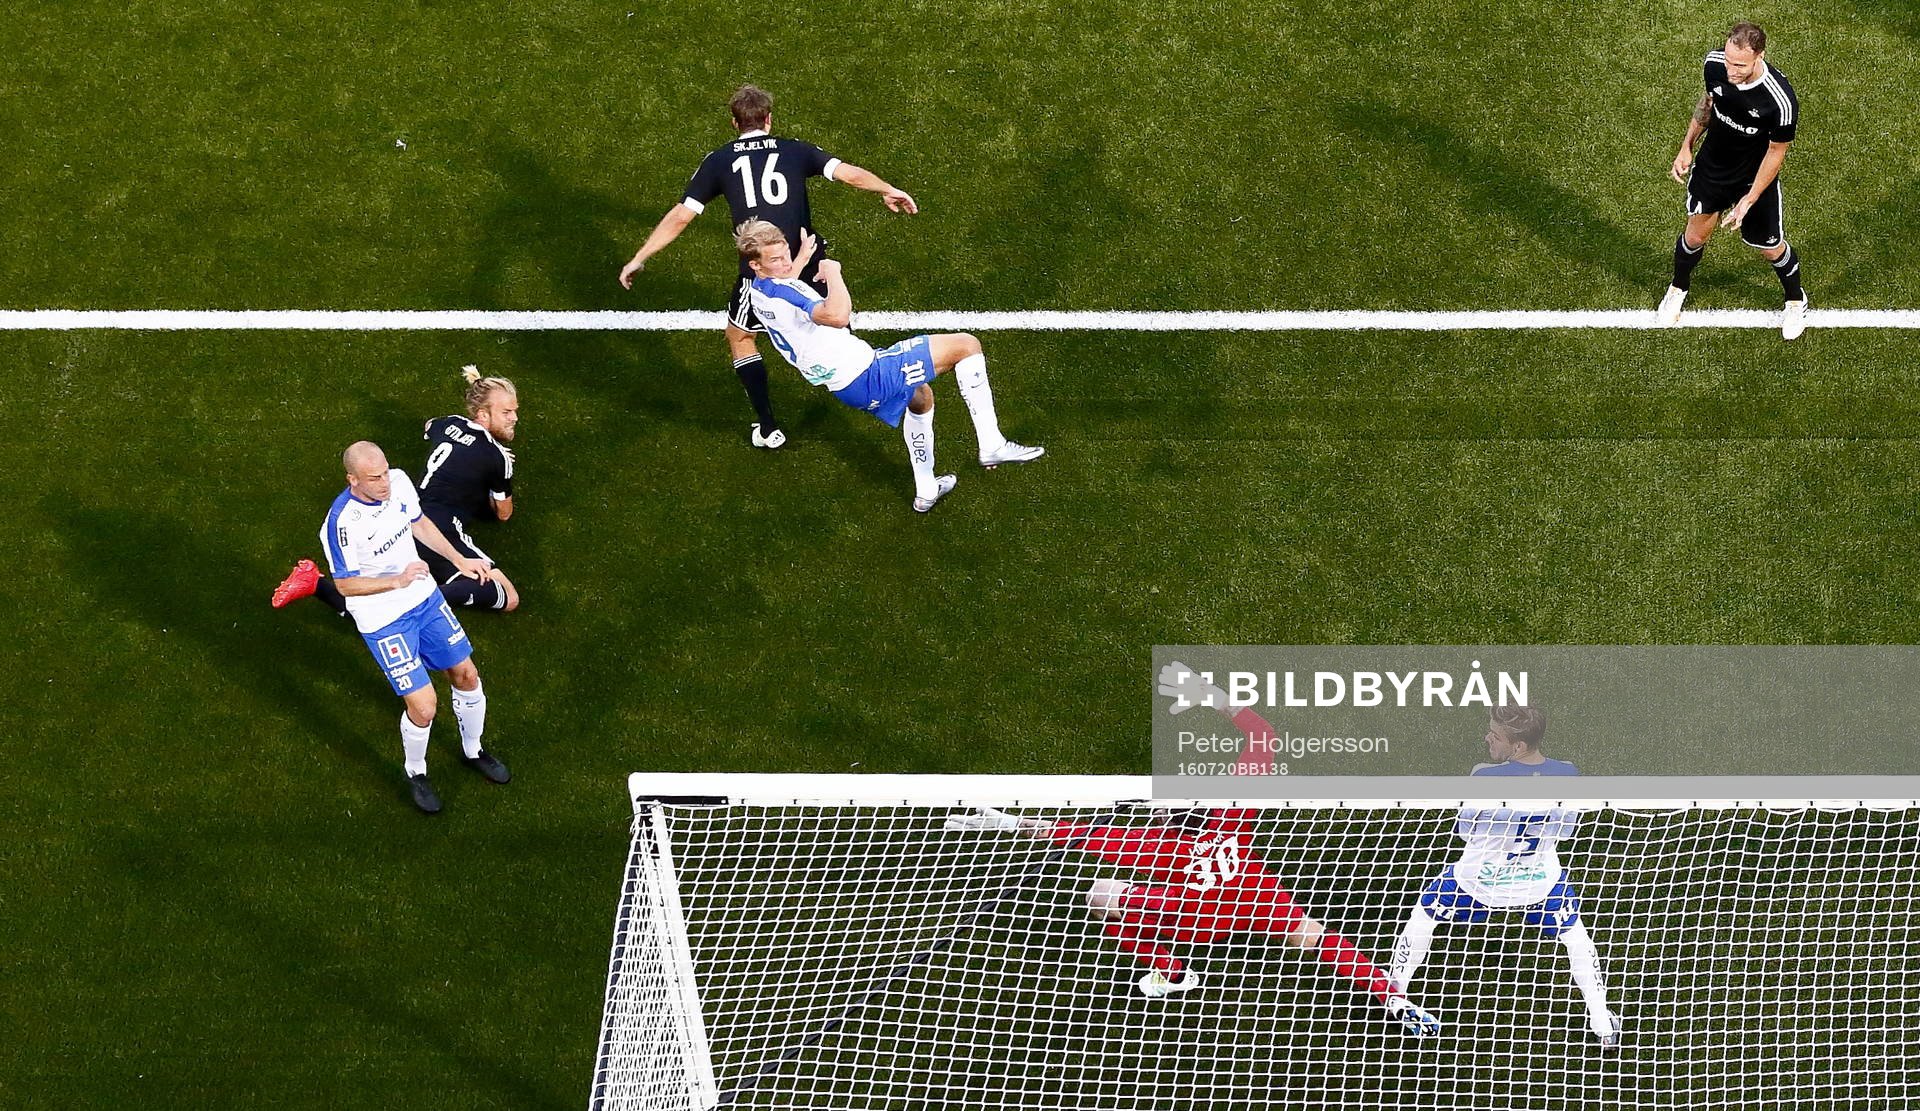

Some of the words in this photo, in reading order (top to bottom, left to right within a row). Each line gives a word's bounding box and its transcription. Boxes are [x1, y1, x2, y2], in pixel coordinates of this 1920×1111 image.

[733, 139, 777, 152] SKJELVIK
[731, 153, 788, 208] 16
[420, 442, 453, 489] 9
[911, 432, 927, 463] Suez
[396, 675, 413, 691] 20
[1506, 815, 1551, 861] 5
[1183, 836, 1239, 891] 30
